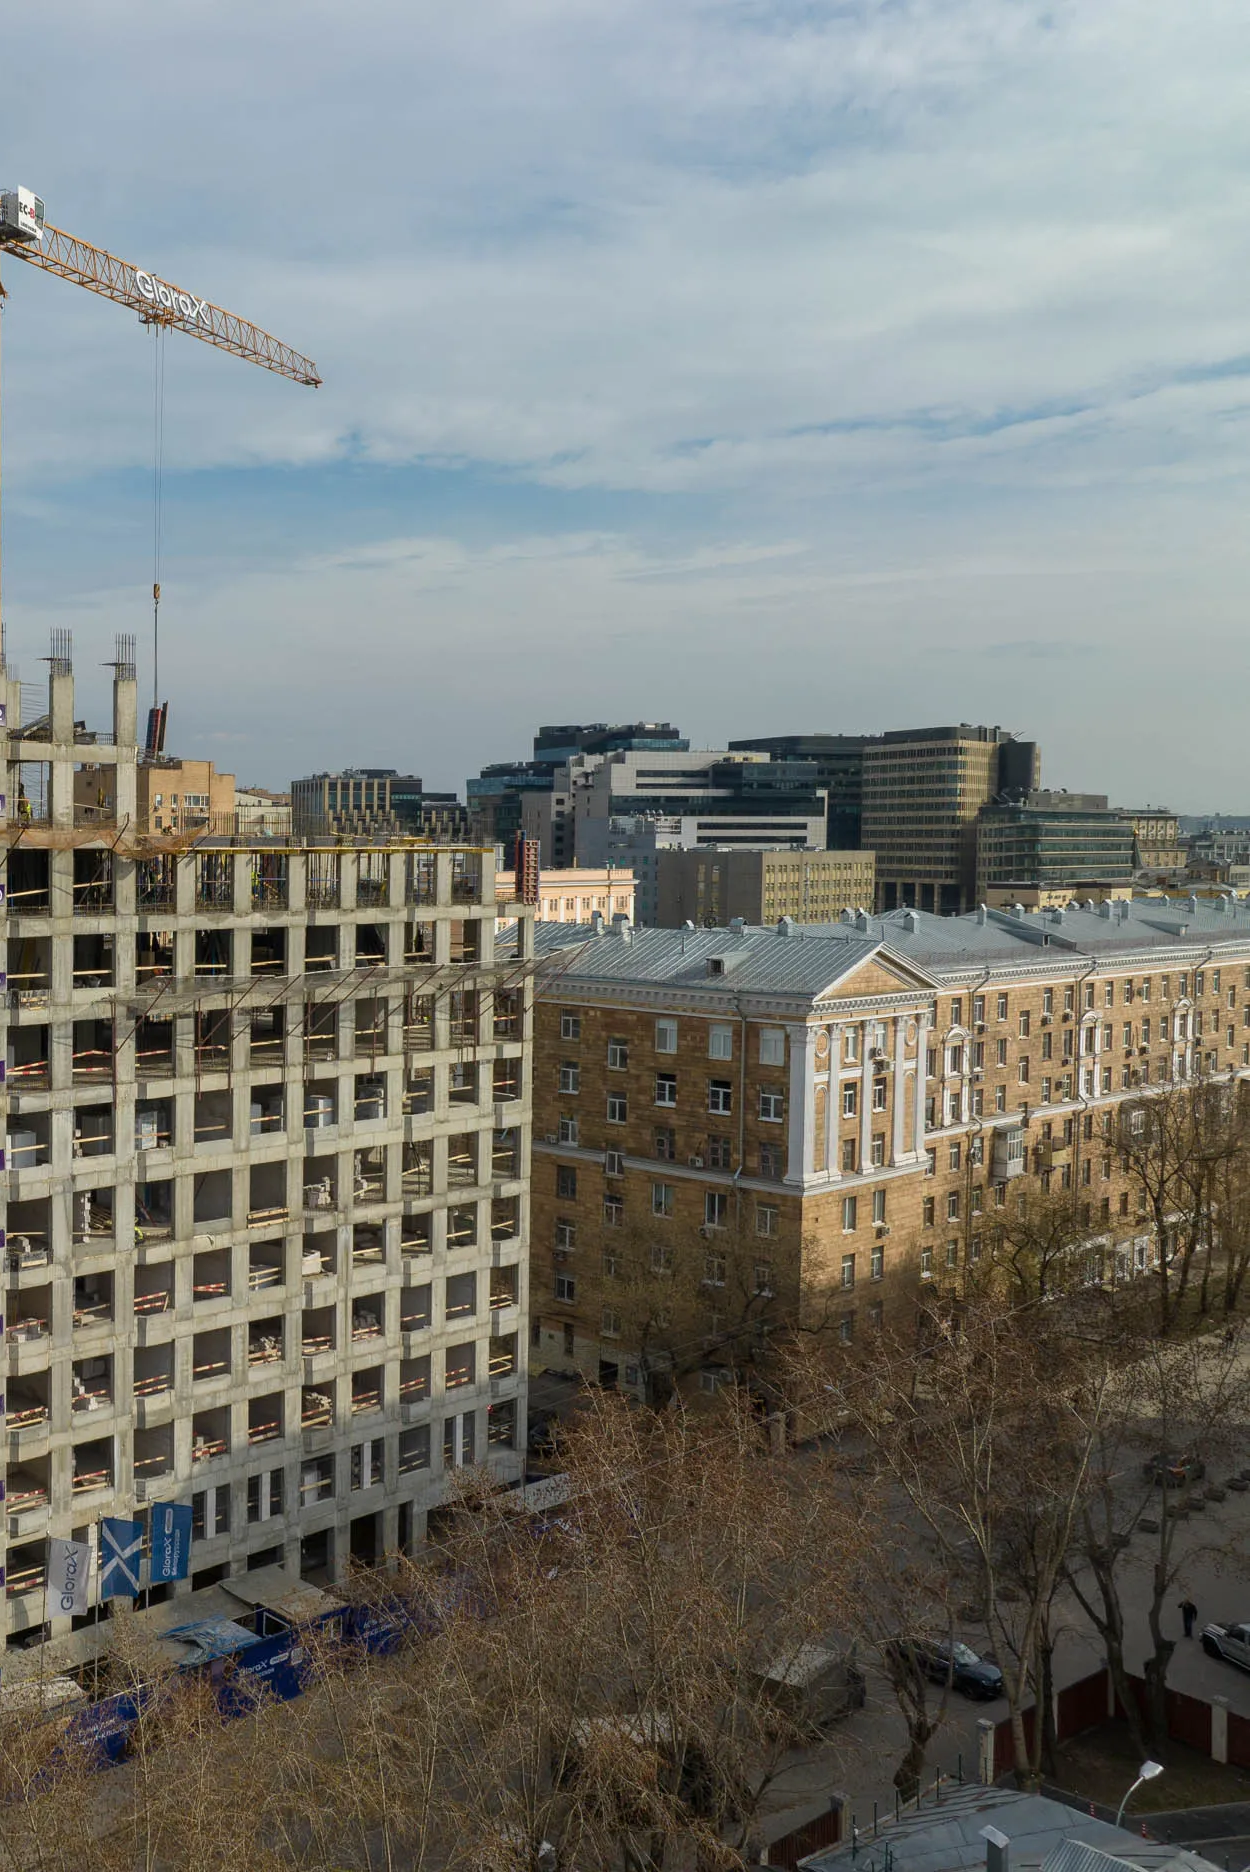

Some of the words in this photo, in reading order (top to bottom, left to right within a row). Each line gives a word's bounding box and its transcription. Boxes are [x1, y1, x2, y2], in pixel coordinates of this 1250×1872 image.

[136, 270, 209, 325] GloraX
[61, 1546, 78, 1610] GloraX
[162, 1537, 171, 1576] GloraX
